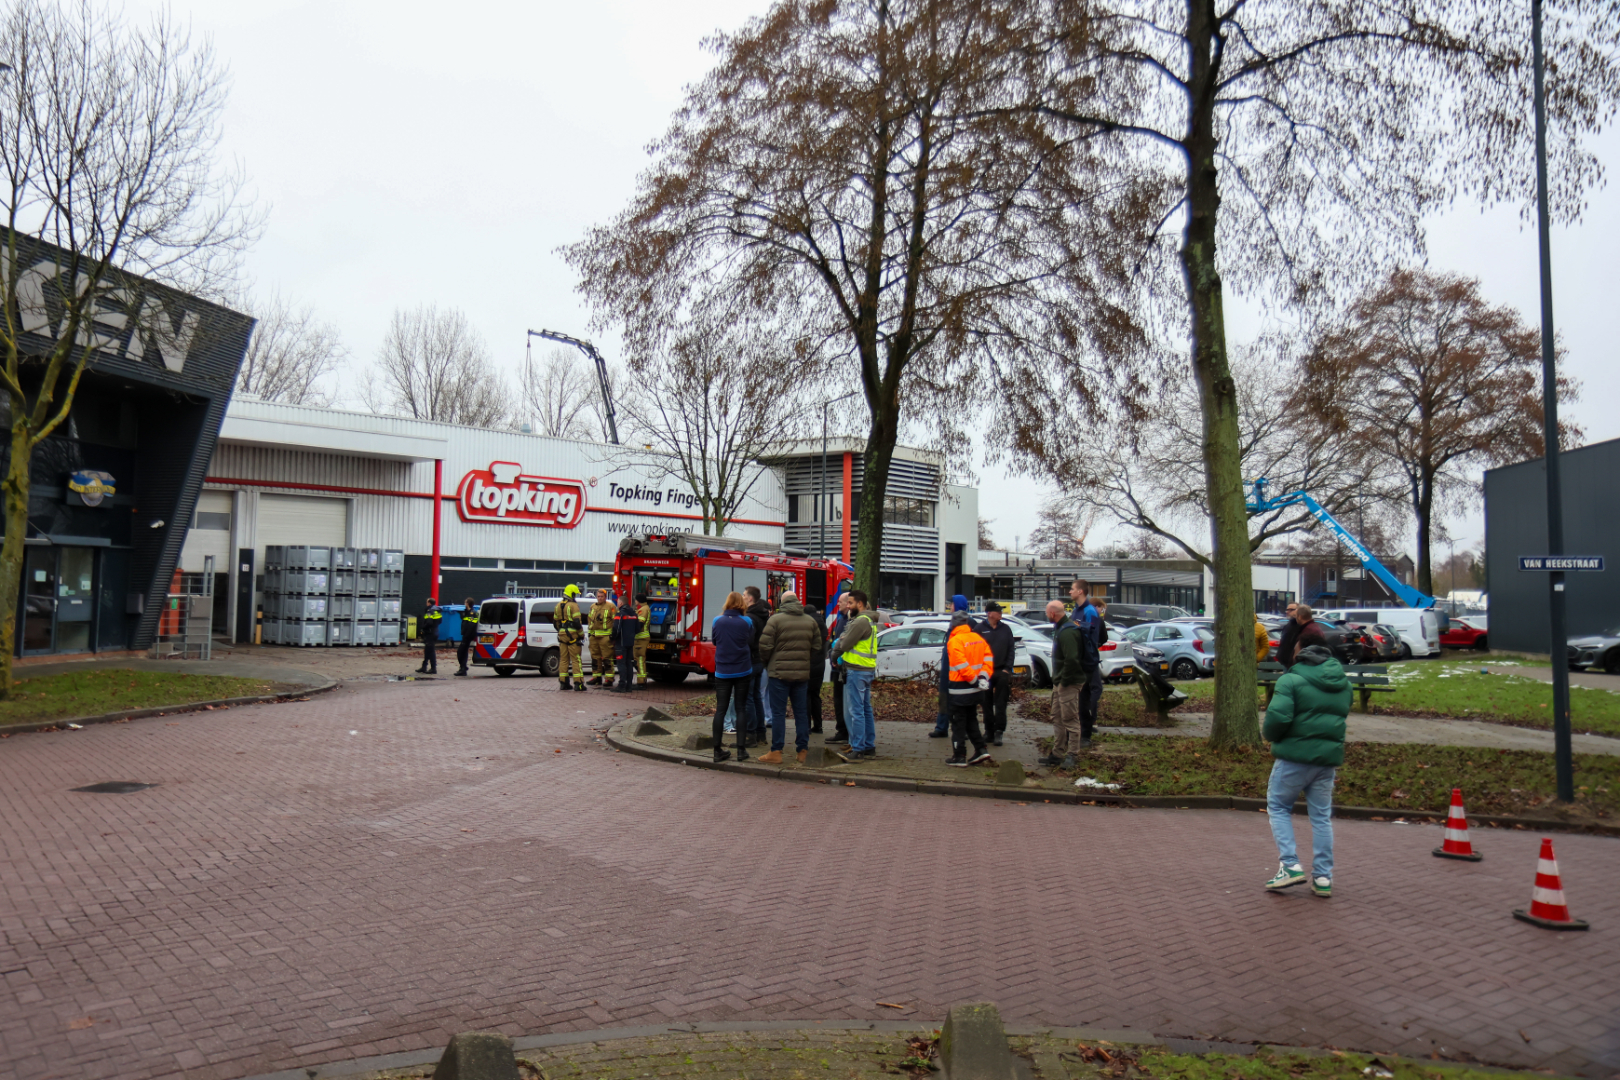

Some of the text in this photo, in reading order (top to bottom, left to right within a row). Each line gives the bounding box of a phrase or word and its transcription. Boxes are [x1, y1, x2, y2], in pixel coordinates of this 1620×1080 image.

[470, 479, 578, 524] topking
[609, 482, 662, 506] Topking
[608, 522, 694, 534] www.topkingpl
[1338, 533, 1370, 562] mateco
[1524, 559, 1599, 568] VAN HEEKSTRAAT
